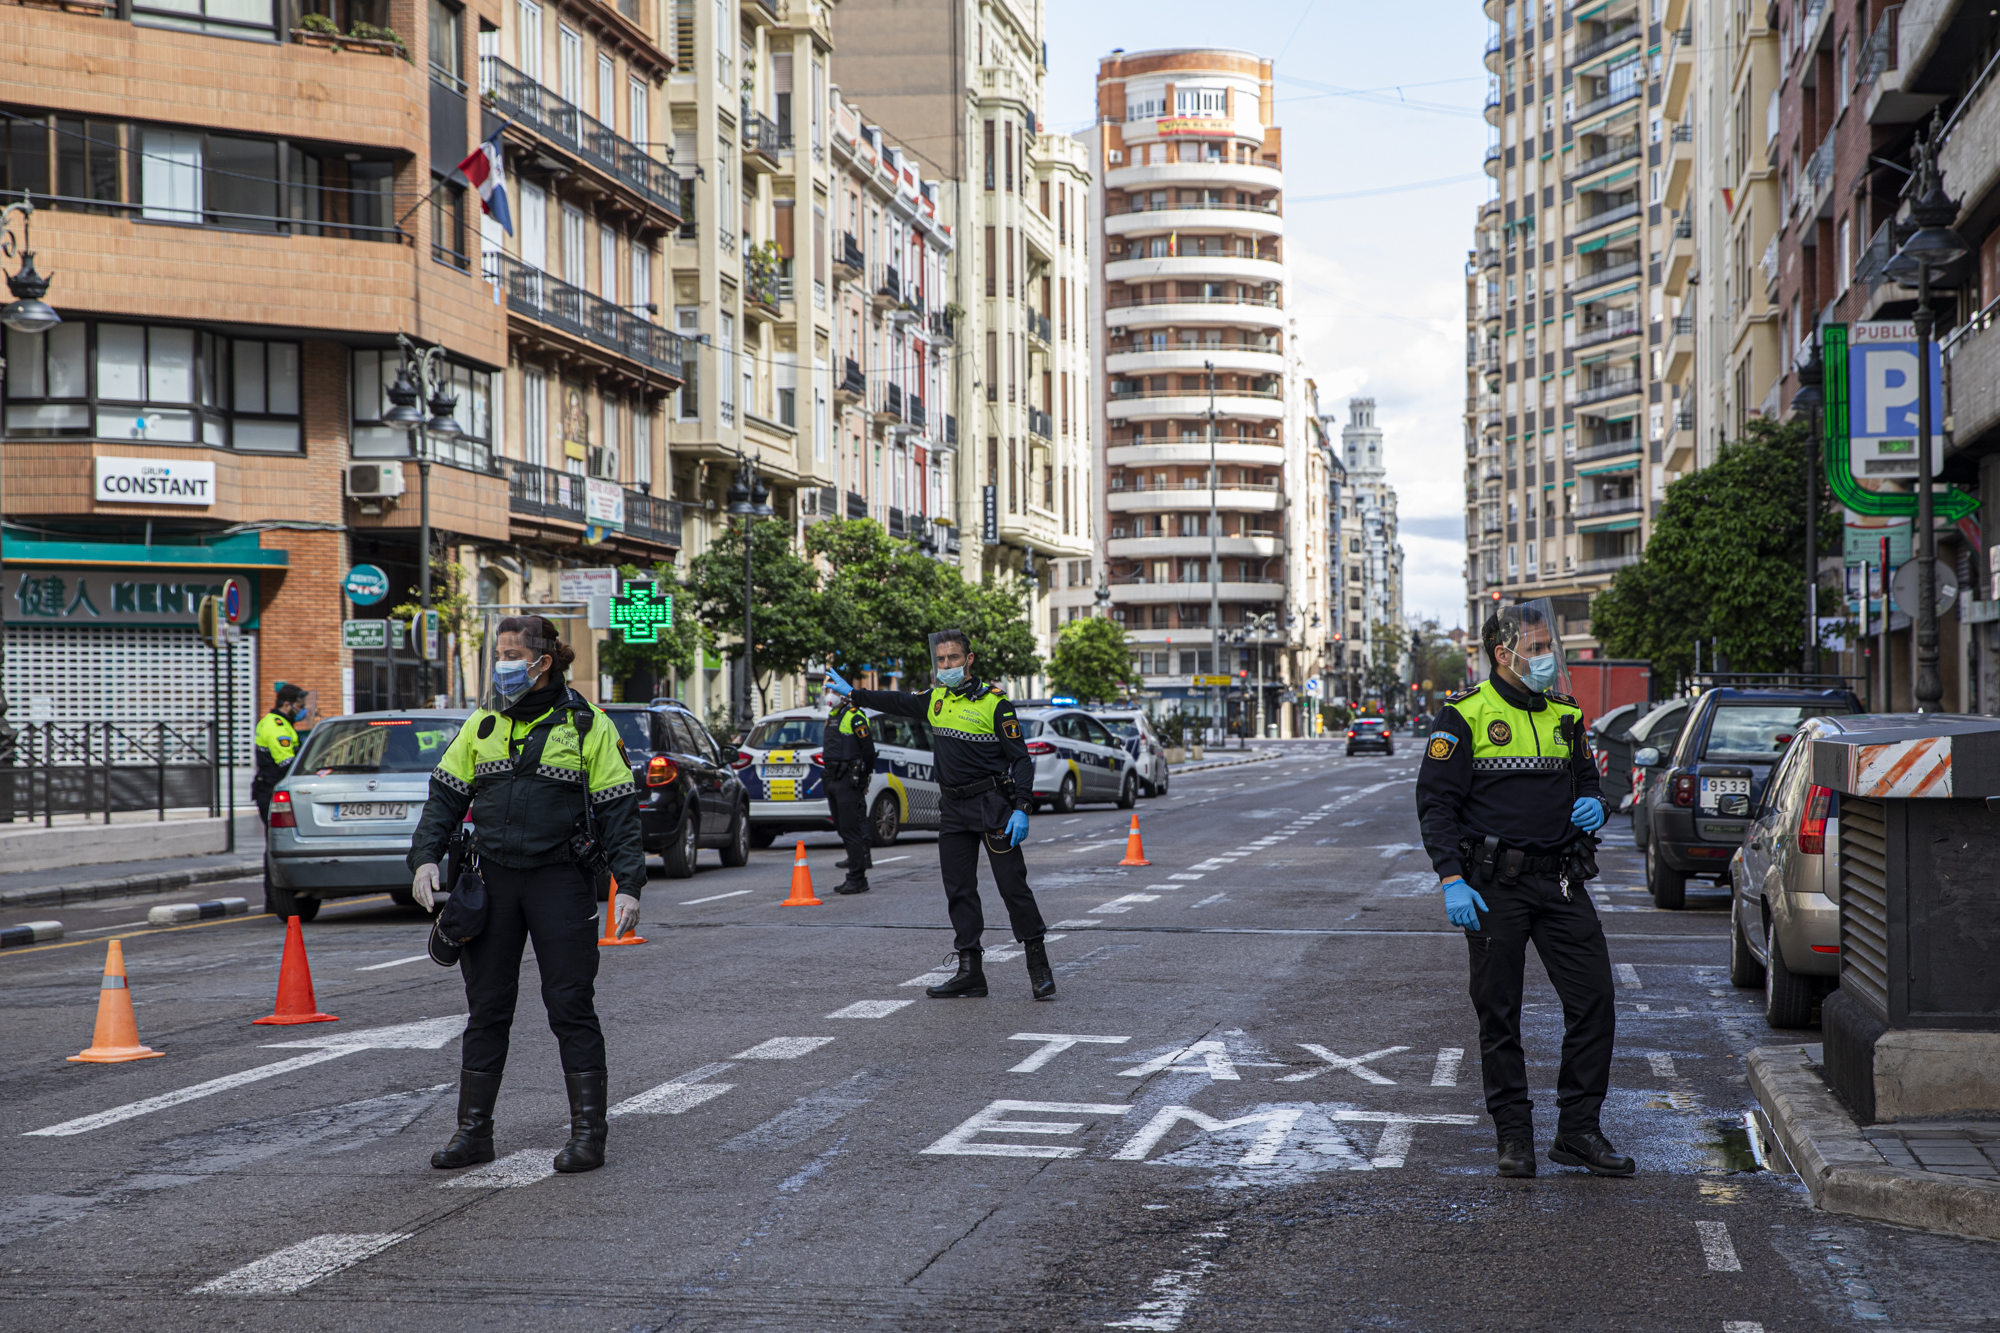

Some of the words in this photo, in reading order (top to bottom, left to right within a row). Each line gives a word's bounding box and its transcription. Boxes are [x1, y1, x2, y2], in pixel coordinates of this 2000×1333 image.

[1857, 325, 1931, 339] PUBLIC
[1865, 350, 1919, 433] P
[103, 476, 208, 496] CONSTANT
[350, 573, 380, 585] KENTO
[1080, 751, 1095, 765] PLV
[907, 763, 932, 780] PLV
[1710, 780, 1747, 792] 9533
[341, 804, 372, 816] 2408
[379, 803, 403, 816] DVZ
[1007, 1031, 1464, 1086] TAXI
[919, 1099, 1480, 1169] EMT
